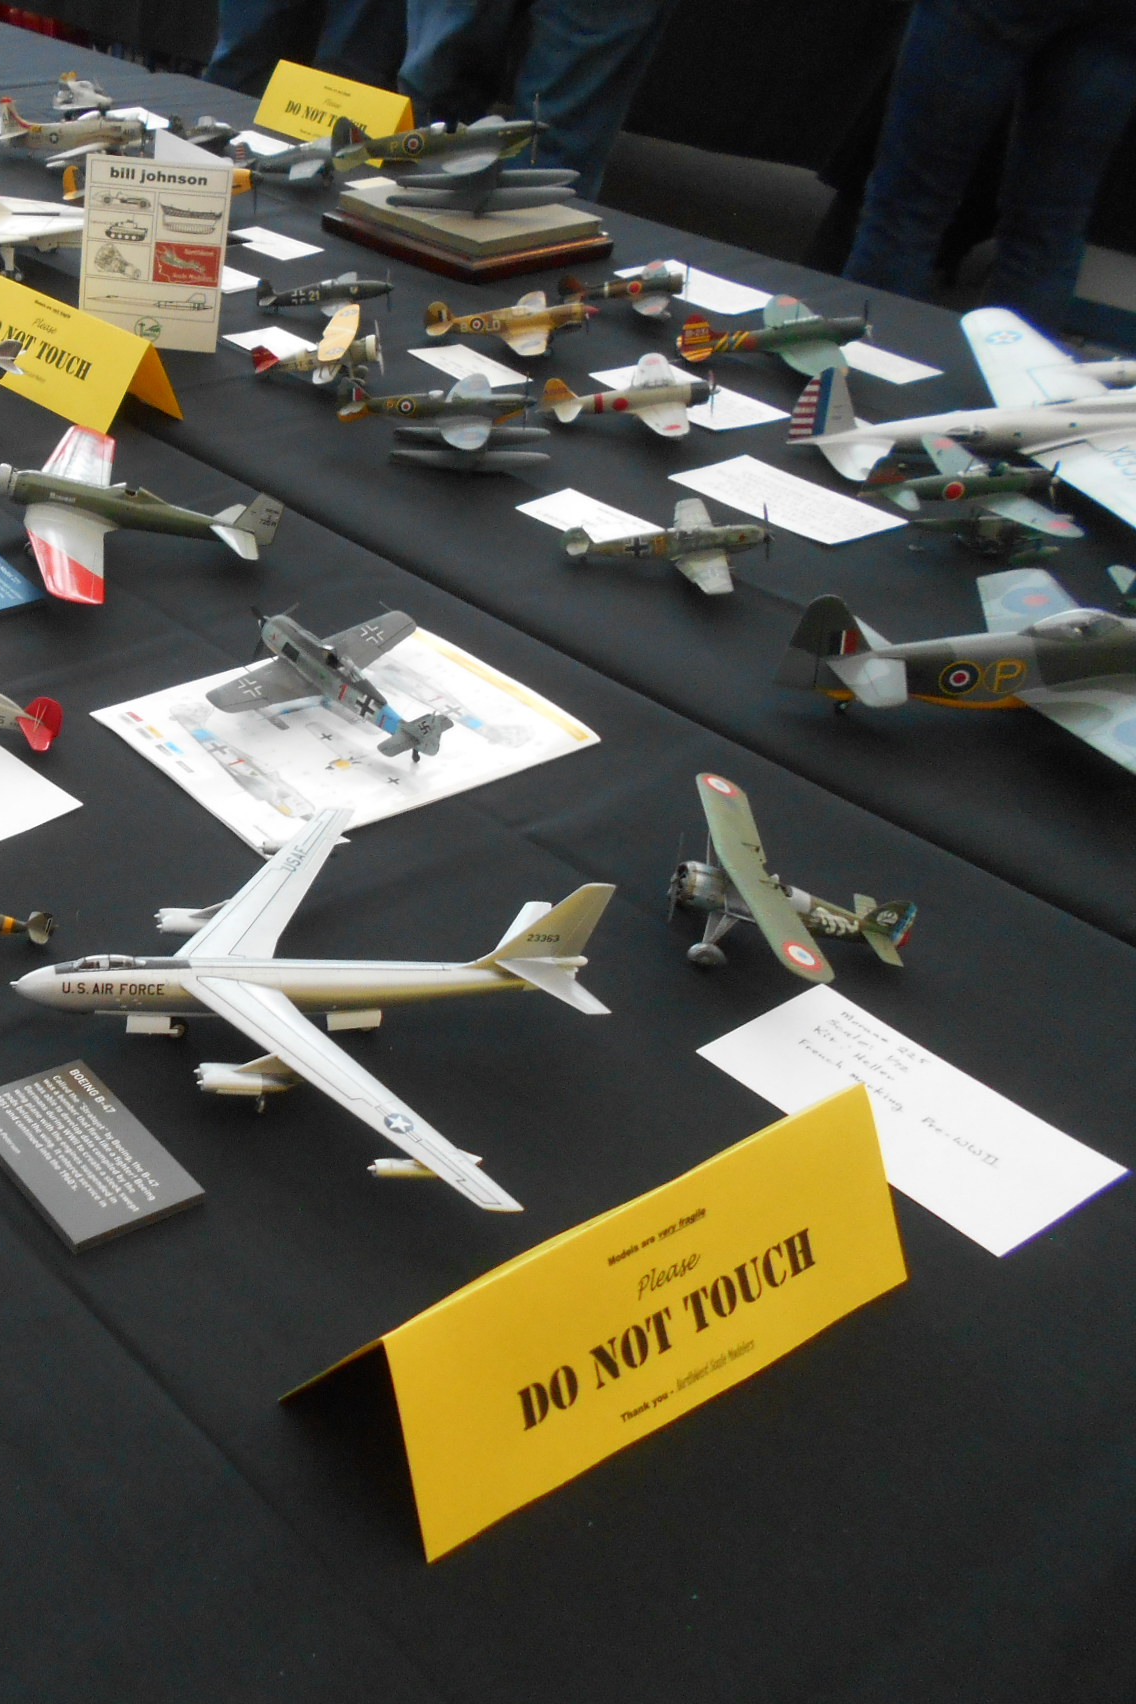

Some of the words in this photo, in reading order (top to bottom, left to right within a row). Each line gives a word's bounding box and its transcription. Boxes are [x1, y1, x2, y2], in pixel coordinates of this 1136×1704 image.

[285, 100, 302, 116] DO
[302, 106, 326, 124] NOT
[110, 167, 135, 180] bill
[139, 169, 208, 186] johnson
[32, 317, 57, 334] Please
[36, 340, 93, 381] TOUCH
[993, 659, 1025, 692] P
[280, 845, 305, 872] USAF
[62, 982, 89, 994] U.S.
[92, 983, 114, 995] AIR
[119, 983, 166, 996] FORCE
[68, 1068, 99, 1096] BOEING
[93, 1095, 116, 1114] B-47
[607, 1245, 639, 1267] Models
[641, 1236, 656, 1249] are
[657, 1224, 677, 1242] very
[677, 1208, 707, 1231] fragile
[637, 1252, 701, 1301] Please
[516, 1365, 579, 1432] DO
[588, 1306, 672, 1390] NOT
[682, 1227, 816, 1333] TOUCH
[620, 1401, 651, 1423] Thank
[652, 1391, 669, 1408] you
